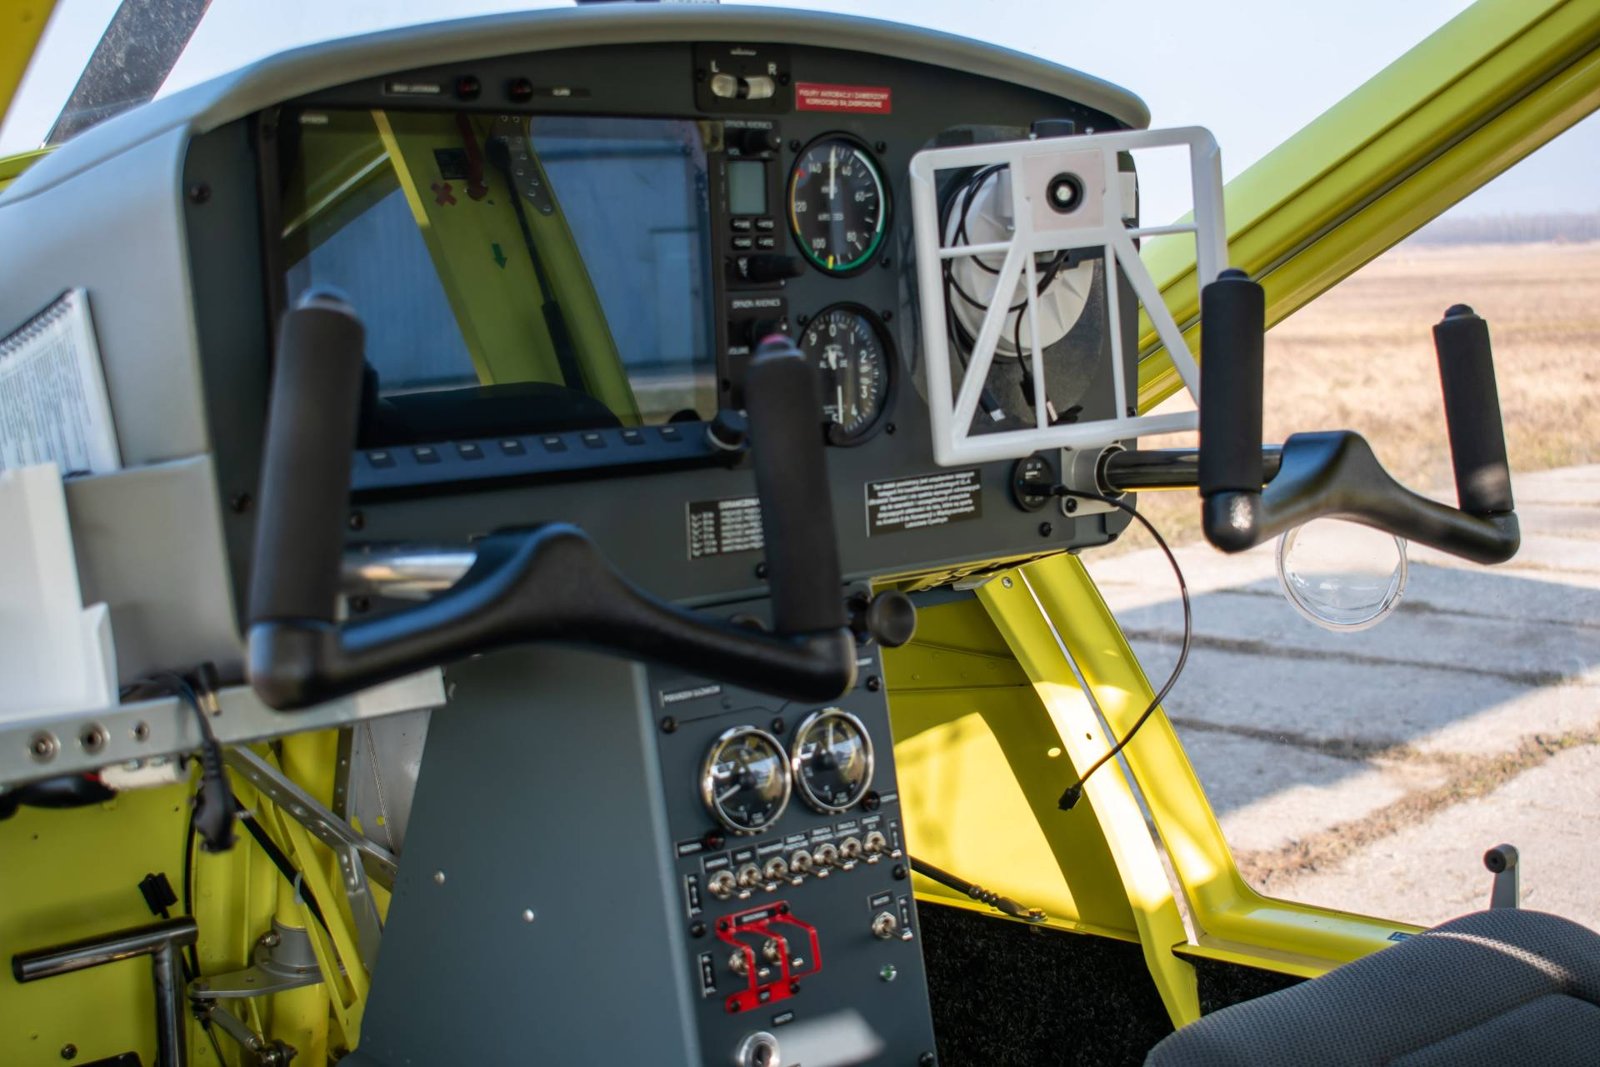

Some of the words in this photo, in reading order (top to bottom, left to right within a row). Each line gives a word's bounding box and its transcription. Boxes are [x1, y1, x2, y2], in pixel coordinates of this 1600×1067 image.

[711, 60, 719, 73] L
[768, 62, 777, 75] R
[809, 163, 822, 173] 140
[842, 165, 852, 176] 40
[855, 191, 865, 202] 60
[813, 238, 826, 249] 100
[847, 232, 857, 243] 80
[829, 324, 837, 337] 0
[810, 332, 817, 346] 9
[860, 350, 867, 363] 2
[860, 385, 867, 399] 3
[851, 403, 858, 416] 4
